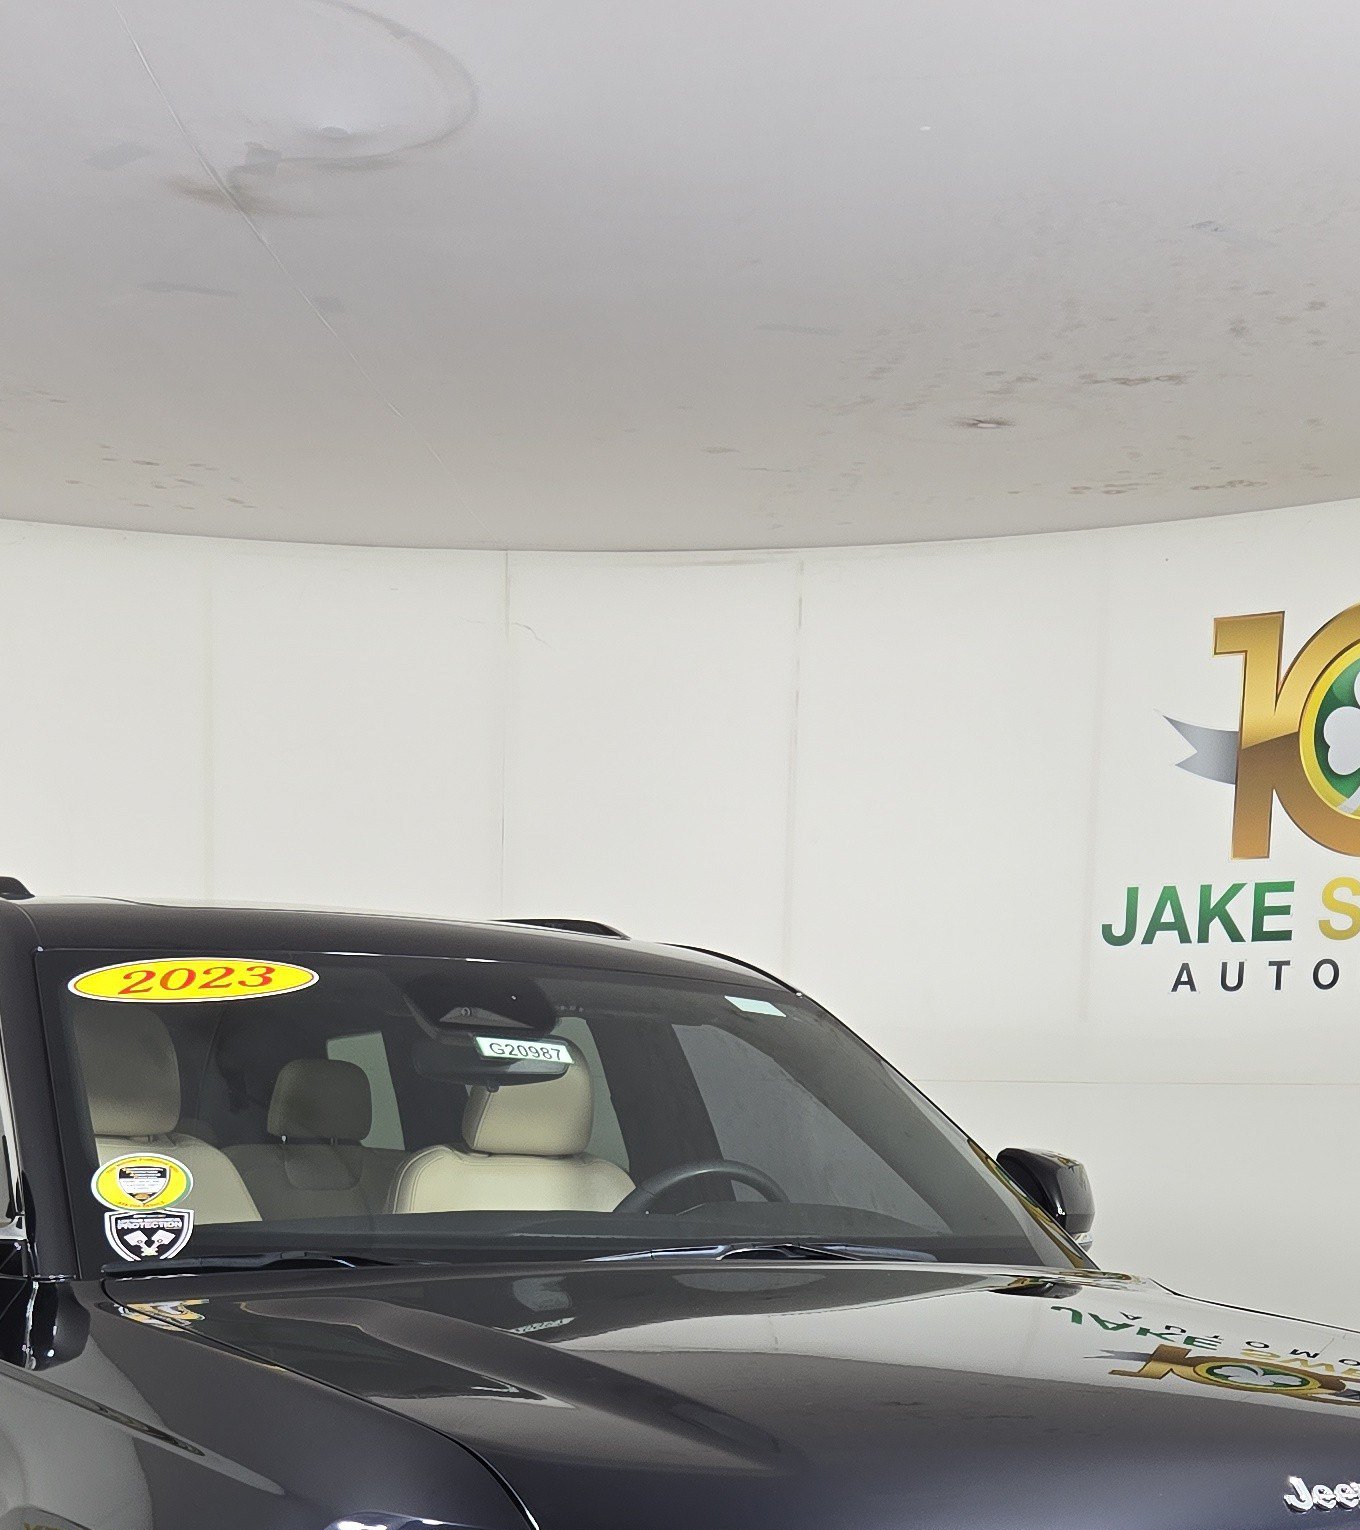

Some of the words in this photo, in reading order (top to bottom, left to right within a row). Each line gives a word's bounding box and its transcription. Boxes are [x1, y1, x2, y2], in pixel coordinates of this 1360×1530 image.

[1101, 880, 1296, 947] JAKE
[118, 966, 276, 996] 2023
[489, 1042, 562, 1061] G20987
